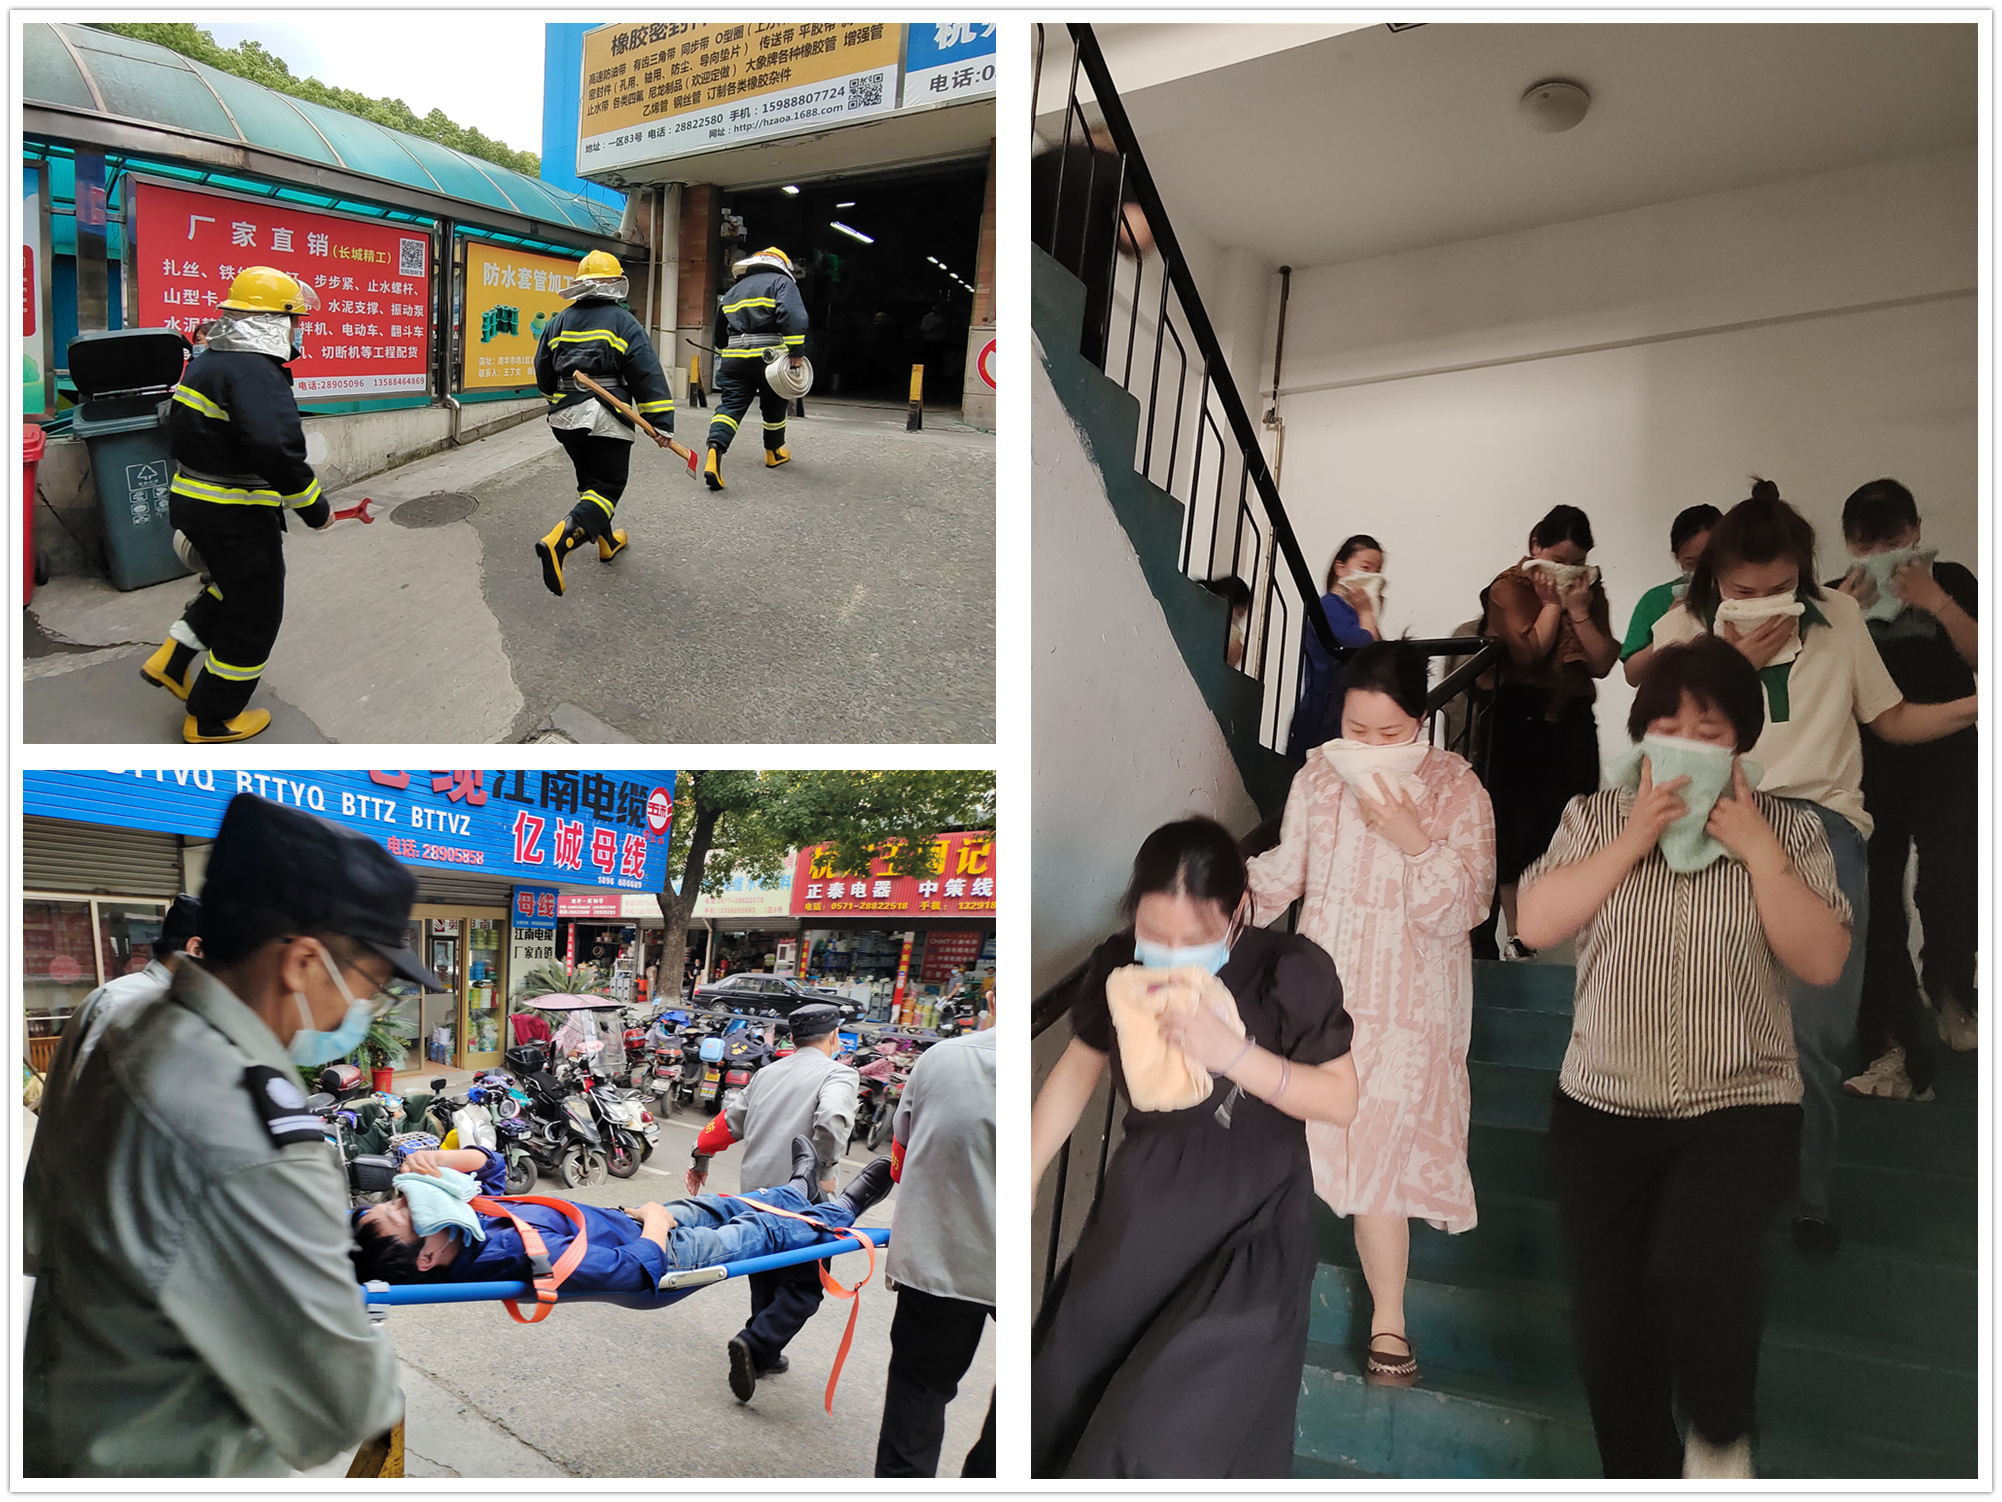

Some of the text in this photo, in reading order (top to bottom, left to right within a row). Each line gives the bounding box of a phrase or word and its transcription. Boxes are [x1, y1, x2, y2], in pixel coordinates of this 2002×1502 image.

[611, 23, 707, 57] 橡胶密封
[760, 28, 795, 51] 传送带
[587, 100, 610, 117] 止水带
[746, 35, 837, 73] 大象牌各种橡胶管
[843, 23, 884, 47] 增强管
[588, 63, 627, 86] 高速防油带
[633, 47, 677, 72] 有齿三角带
[681, 36, 710, 57] 同步带
[930, 65, 996, 92] 电话:0
[643, 68, 792, 117] 乙烯管 钢丝管 订制各类橡胶杂件
[188, 214, 329, 257] 厂家直销
[164, 288, 218, 306] 山型卡
[164, 316, 218, 333] 水泥
[373, 377, 425, 387] 13588464869
[236, 770, 325, 811] BTTYQ
[342, 792, 397, 824] BTTZ
[411, 805, 471, 836] BTTVZ
[493, 770, 649, 828] 江南电缆
[512, 809, 648, 879] 亿诚母线
[805, 877, 994, 900] 正泰电器 中策线
[517, 891, 556, 918] 母线
[514, 927, 554, 941] 江南电缆
[514, 945, 554, 960] 厂家直销
